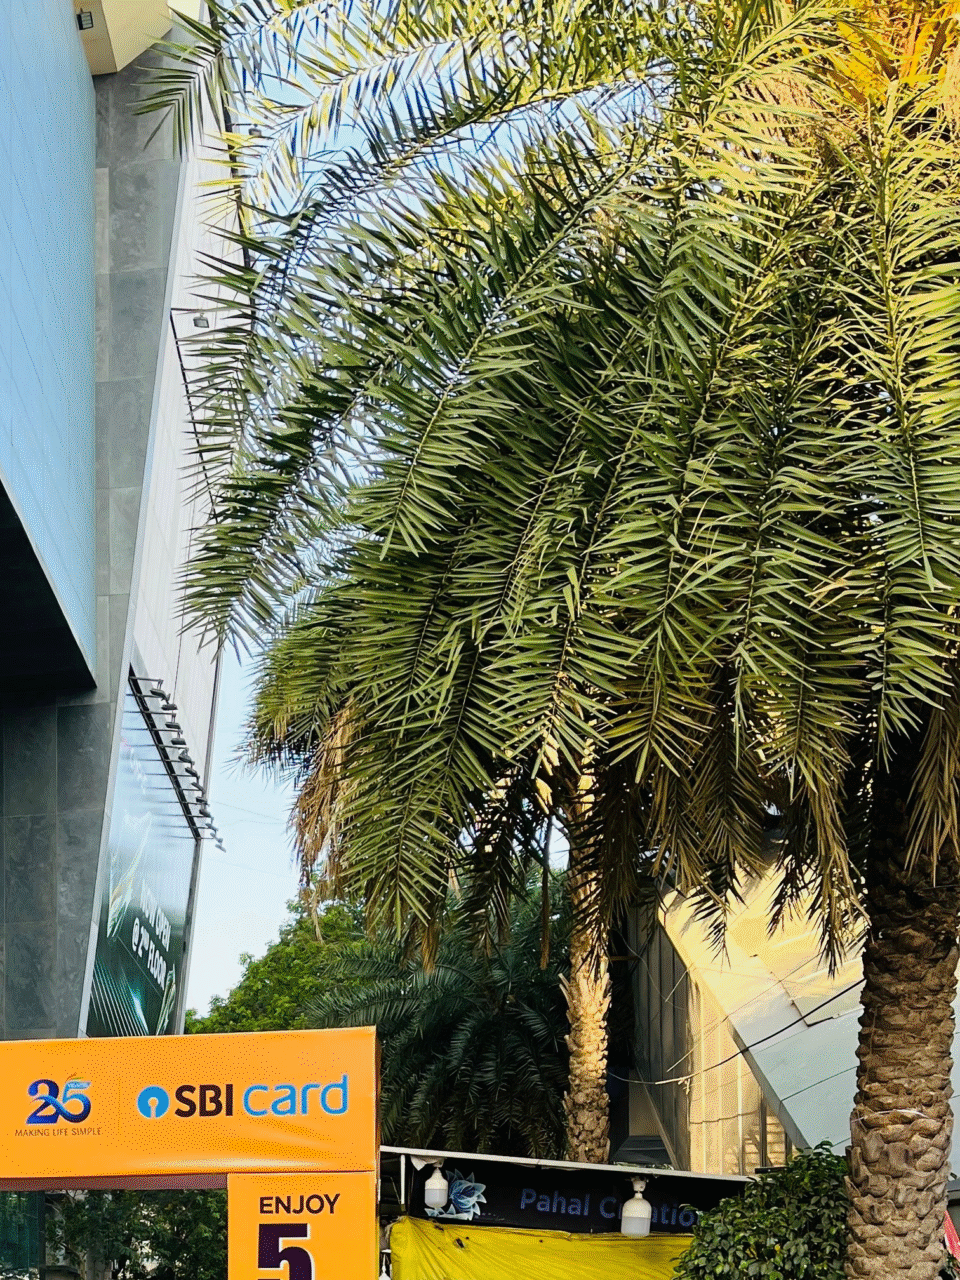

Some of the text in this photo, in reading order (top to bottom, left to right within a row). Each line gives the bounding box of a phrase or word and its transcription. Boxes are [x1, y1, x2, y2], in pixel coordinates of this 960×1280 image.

[174, 1075, 348, 1117] SBI card
[15, 1127, 102, 1137] MAKING LIFE SIMPLE
[260, 1194, 340, 1214] ENJOY
[520, 1188, 591, 1216] Pahal
